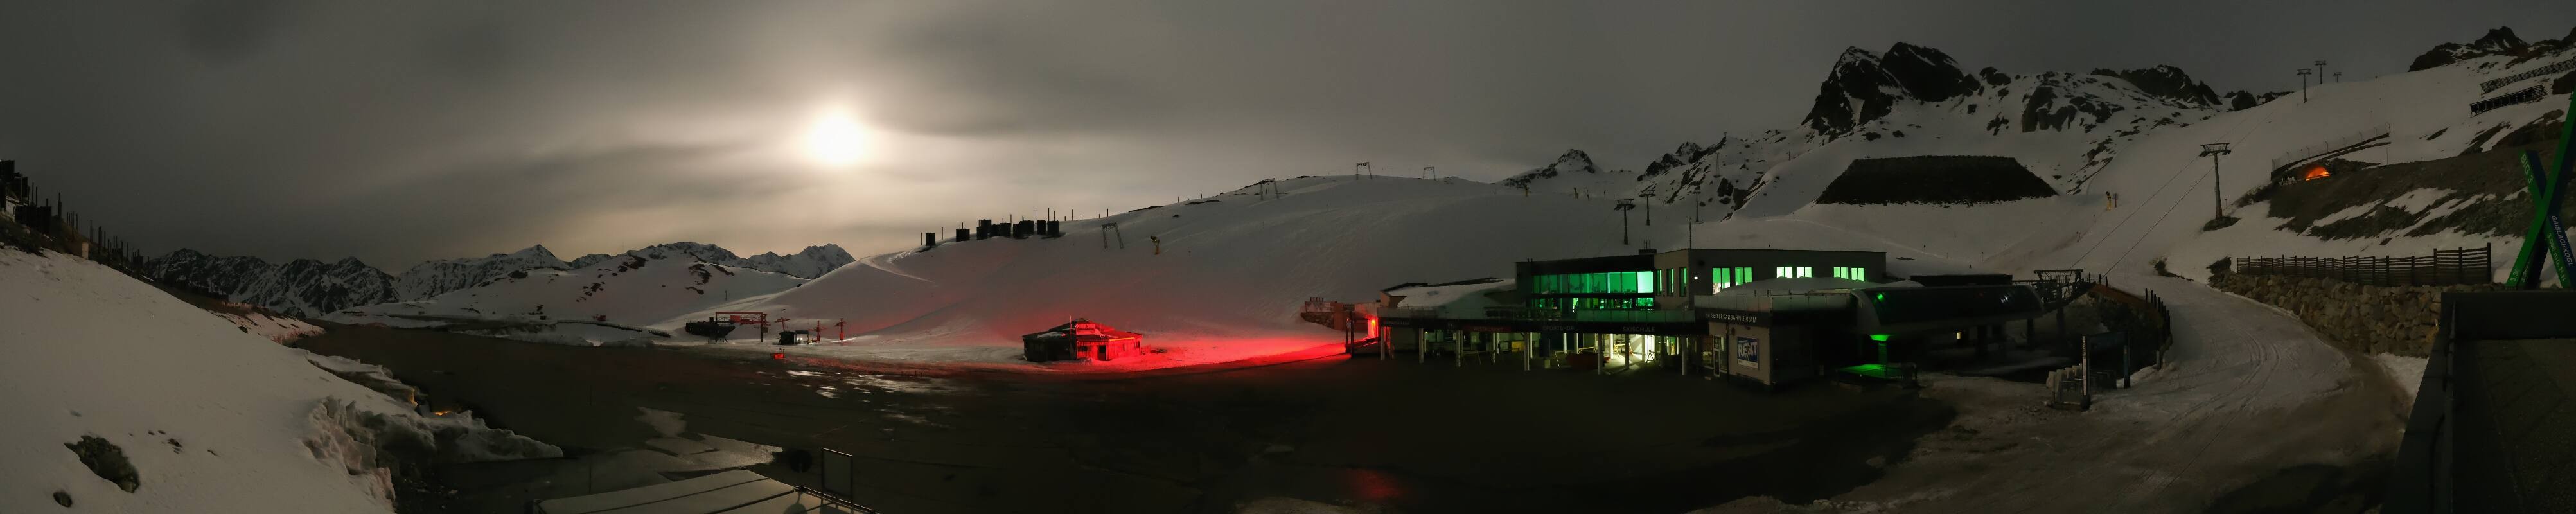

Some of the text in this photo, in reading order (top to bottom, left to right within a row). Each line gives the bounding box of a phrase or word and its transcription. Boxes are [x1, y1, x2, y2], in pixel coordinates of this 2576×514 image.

[2520, 154, 2534, 184] BIG 3
[2551, 215, 2573, 267] GAISLACHKOGL
[1738, 342, 1758, 357] RENT
